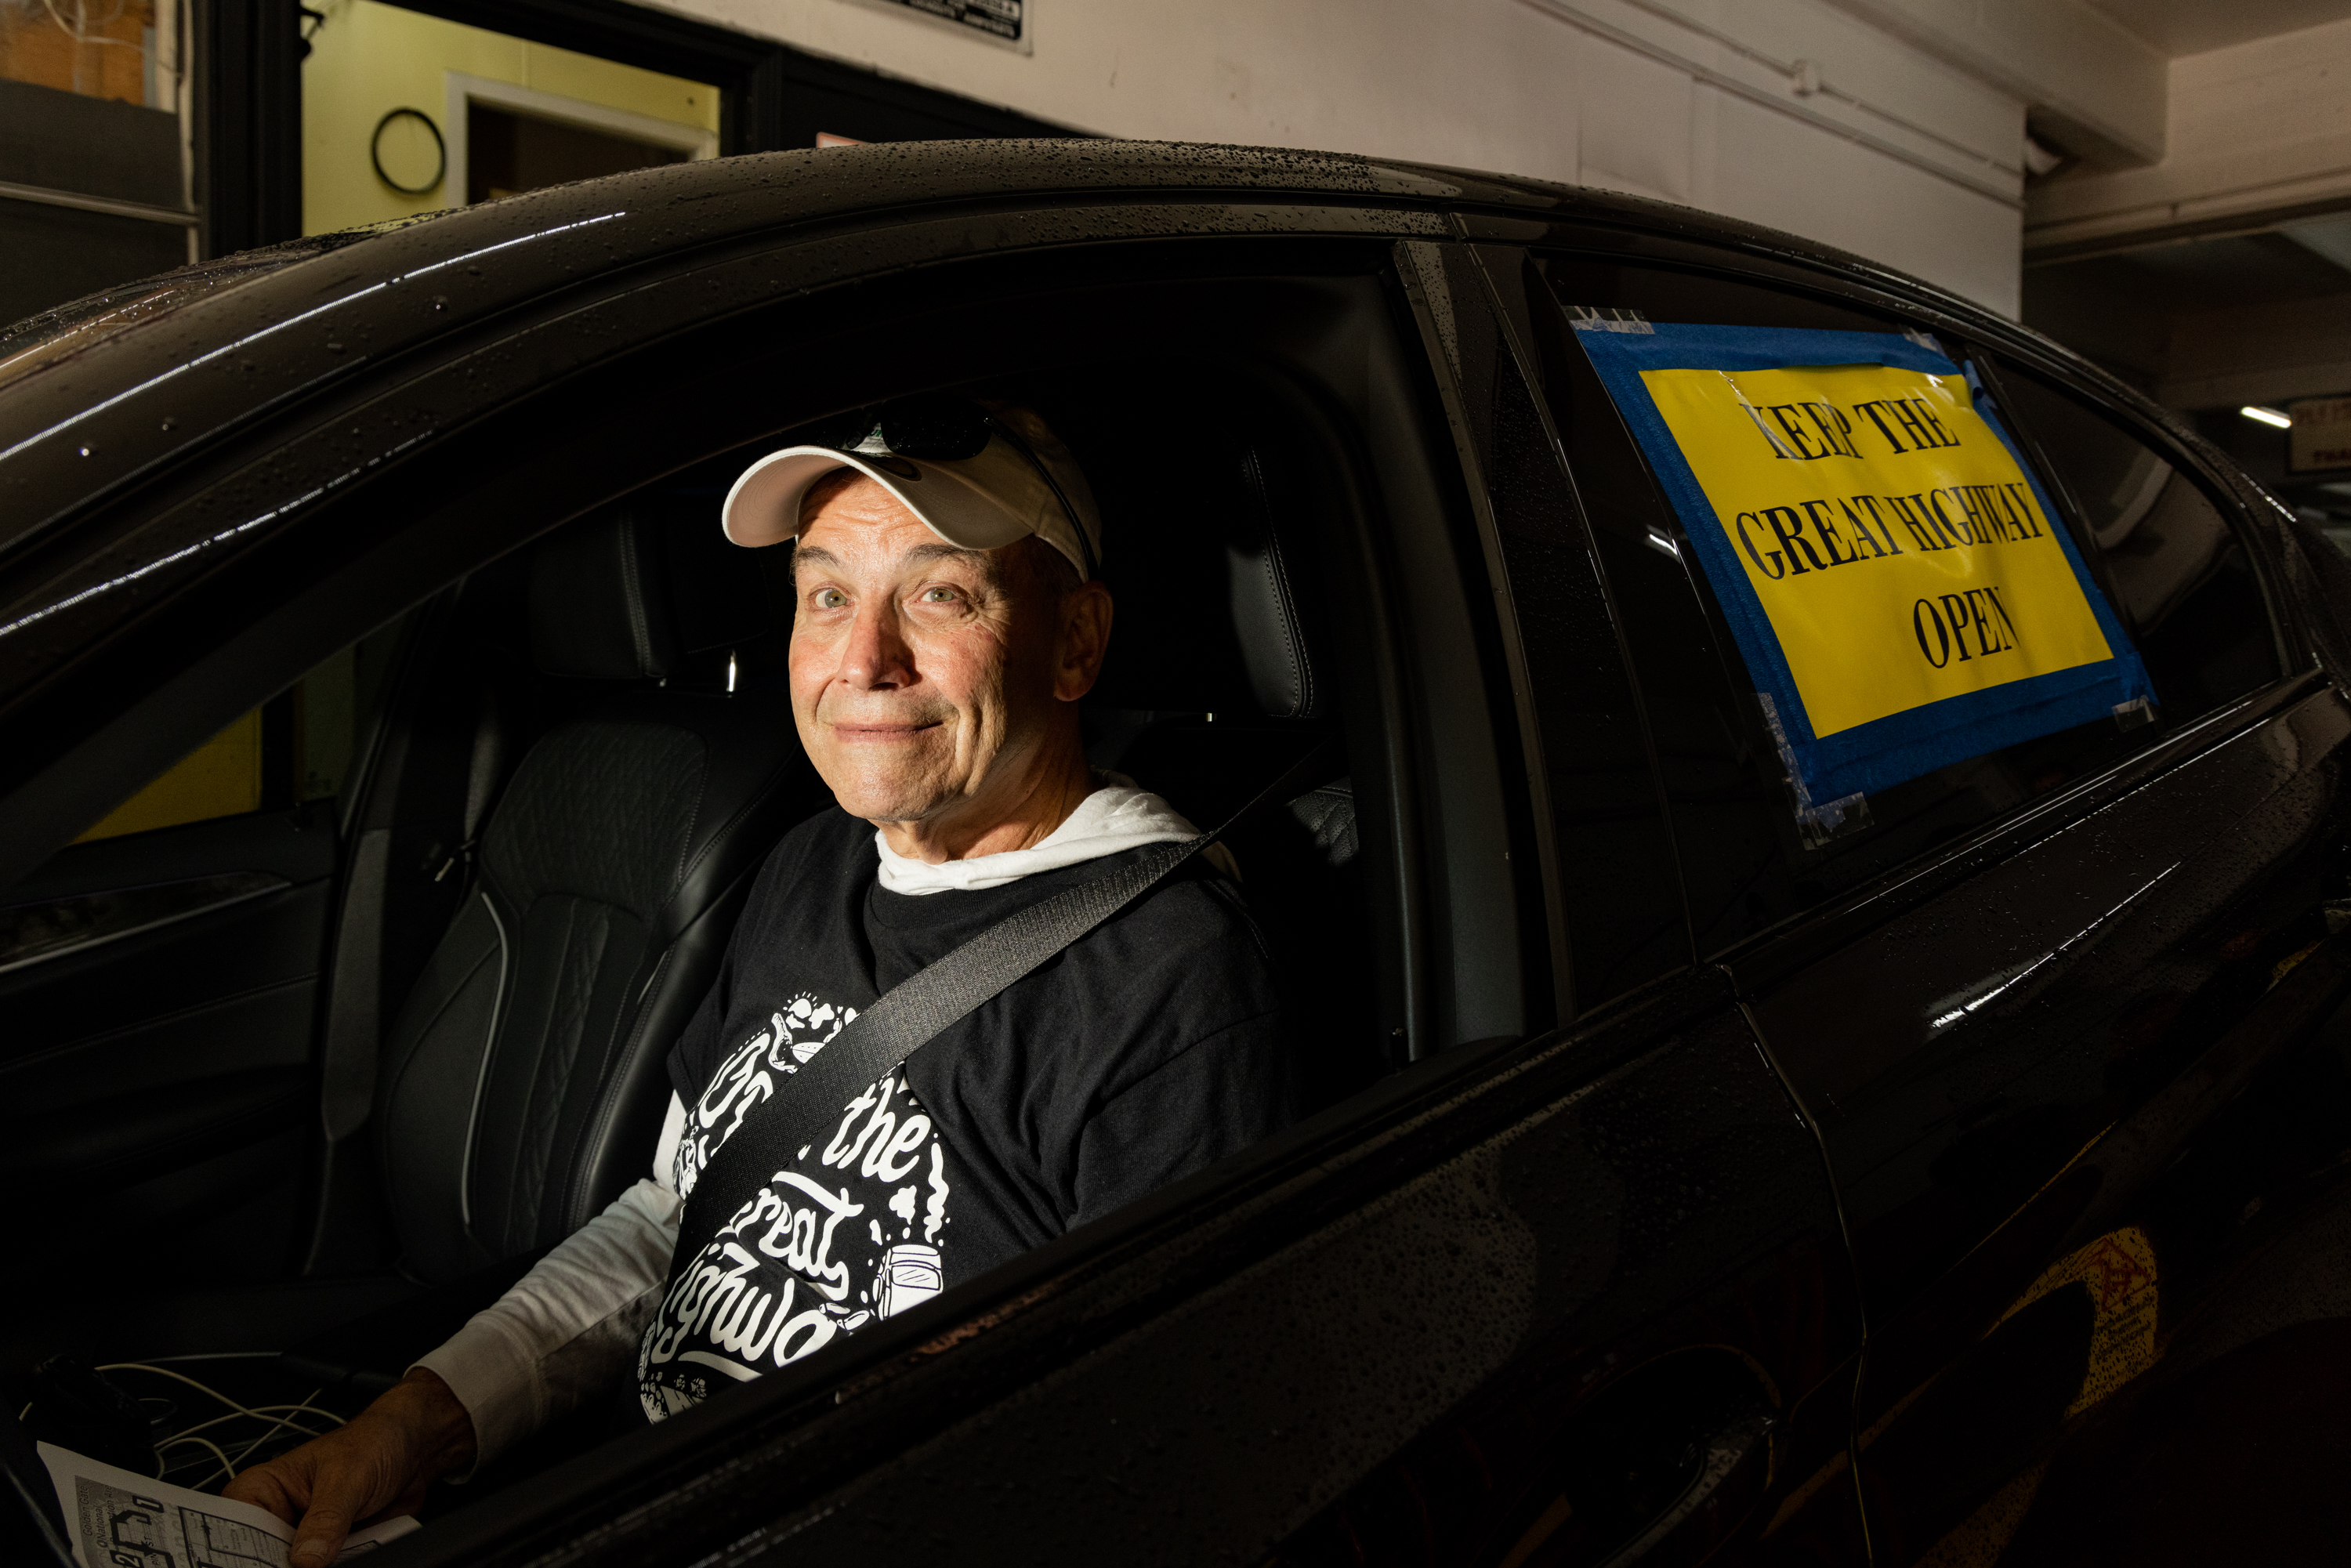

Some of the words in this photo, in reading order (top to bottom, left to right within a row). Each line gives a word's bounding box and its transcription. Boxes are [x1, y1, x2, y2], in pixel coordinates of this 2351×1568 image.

[1738, 402, 1864, 461] KEEP
[1853, 398, 1962, 454] THE
[1736, 494, 1903, 580] GREAT
[1883, 482, 2044, 552] HIGHWAY
[1913, 586, 2020, 668] OPEN
[822, 1077, 931, 1182] the
[729, 1171, 864, 1301] reat
[79, 1485, 89, 1505] Gate
[82, 1505, 93, 1536] Golden
[94, 1505, 107, 1540] National
